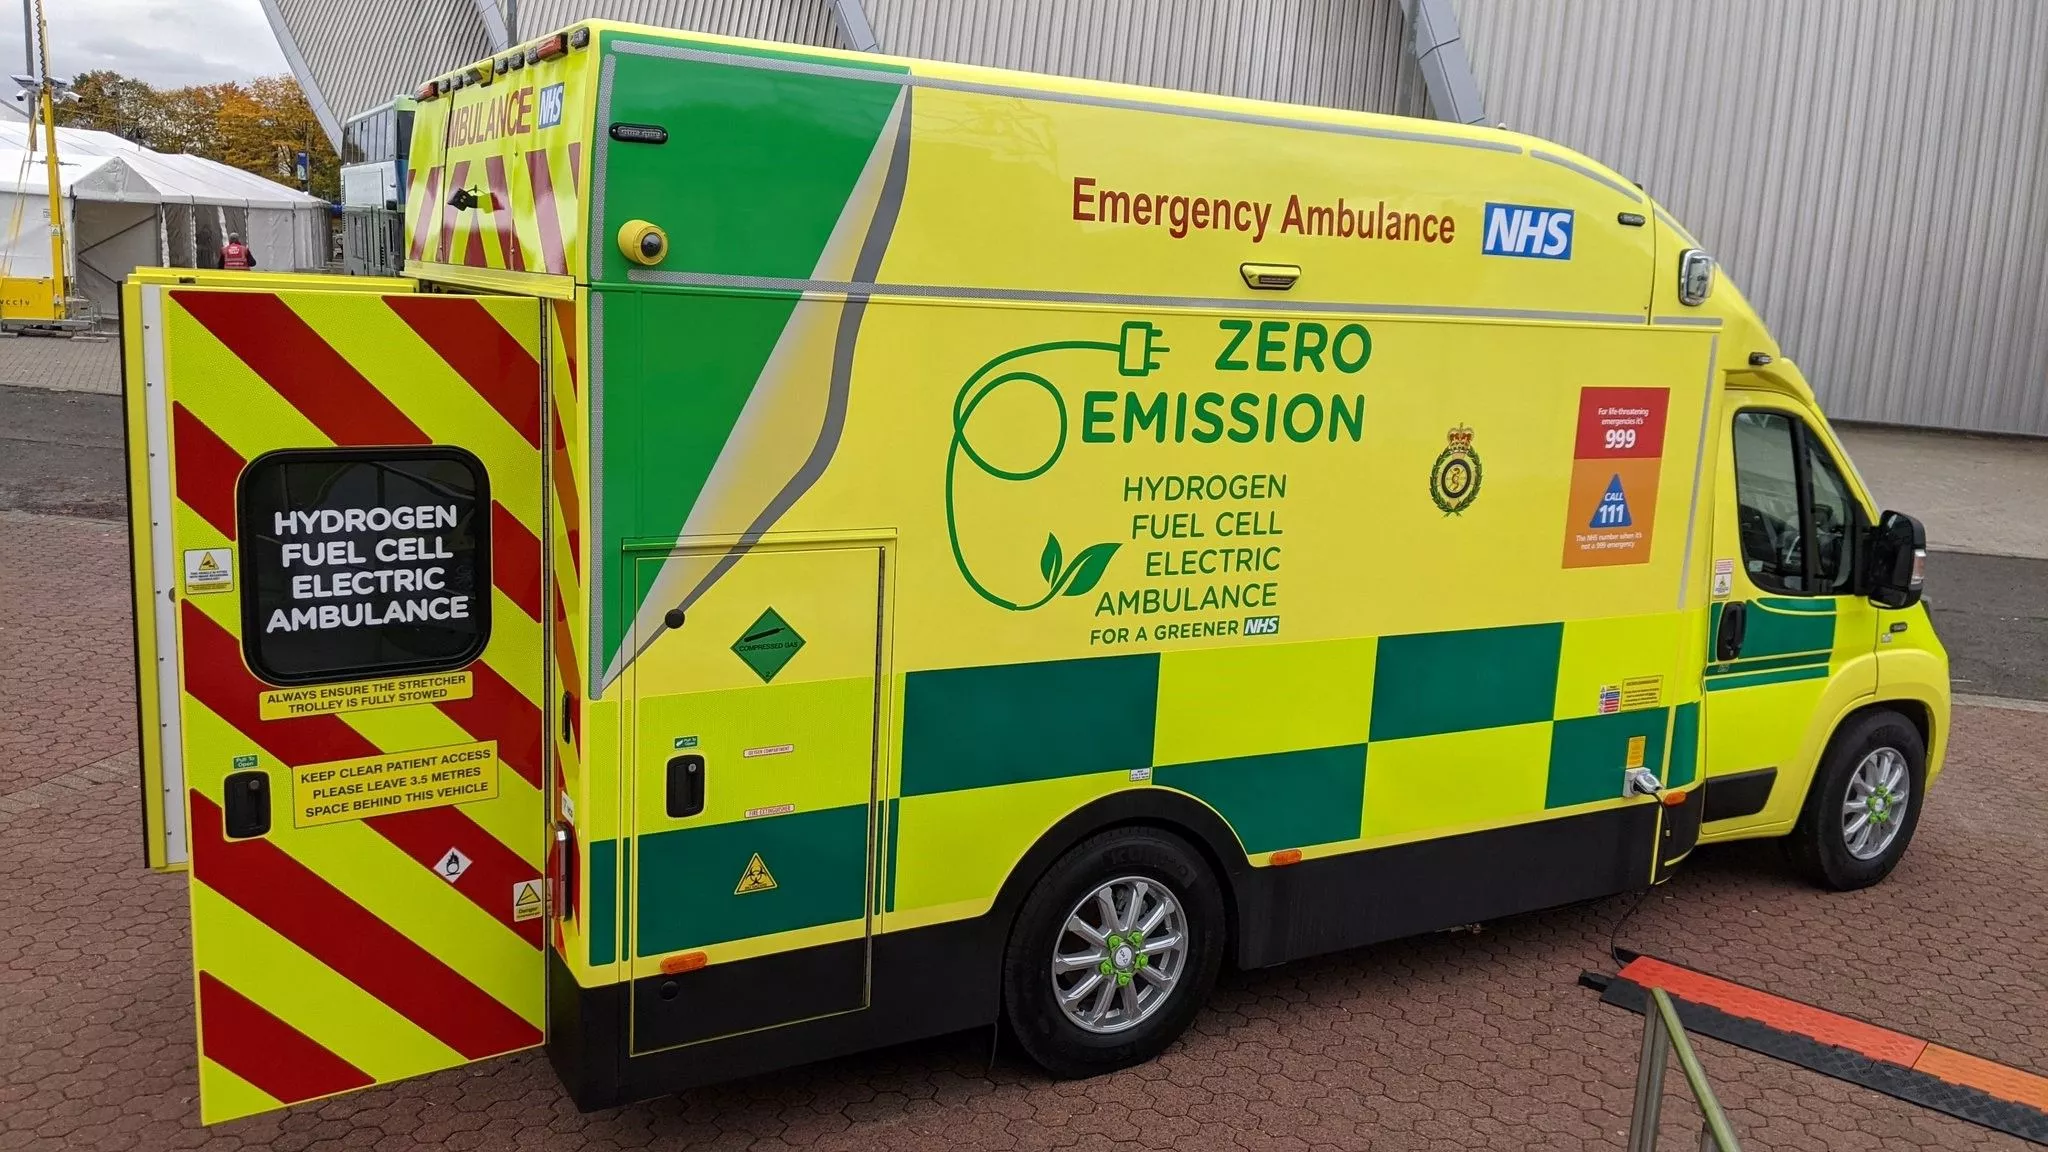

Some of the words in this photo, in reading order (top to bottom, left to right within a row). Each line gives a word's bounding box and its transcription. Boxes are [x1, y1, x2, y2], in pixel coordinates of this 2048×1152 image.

[441, 87, 533, 151] AMBULANCE
[539, 85, 563, 126] NHS
[1073, 176, 1272, 243] Emergency
[1280, 193, 1456, 245] Ambulance
[1484, 206, 1572, 257] NHS
[1214, 319, 1372, 373] ZERO
[1081, 391, 1365, 444] EMISSION
[1598, 407, 1607, 415] For
[1609, 407, 1649, 417] life-threatening
[1601, 418, 1635, 426] emergencies
[1605, 429, 1636, 449] 999
[1123, 474, 1287, 502] HYDROGEN
[1604, 492, 1624, 501] CALL
[275, 504, 457, 536] HYDROGEN
[1131, 513, 1205, 539] FUEL
[1215, 510, 1283, 536] CELL
[1599, 504, 1624, 524] 111
[282, 540, 366, 568] FUEL
[375, 536, 453, 561] CELL
[1145, 546, 1281, 576] ELECTRIC
[292, 567, 445, 600] ELECTRIC
[266, 596, 469, 634] AMBULANCE
[1095, 582, 1278, 617] AMBULANCE
[1090, 627, 1128, 645] FOR
[1135, 626, 1147, 641] A
[1154, 621, 1238, 640] GREENER
[1244, 617, 1278, 635] NHS
[739, 643, 783, 651] COMPRESSED
[267, 691, 317, 704] ALWAYS
[320, 685, 368, 698] ENSURE
[374, 682, 396, 693] THE
[398, 675, 466, 690] STRETCHER
[289, 700, 342, 714] TROLLEY
[346, 698, 358, 708] IS
[361, 695, 394, 706] FULLY
[399, 688, 448, 702] STOWED
[301, 770, 336, 784] KEEP
[340, 764, 382, 780] CLEAR
[386, 757, 436, 773] PATIENT
[441, 750, 490, 765] ACCESS
[313, 784, 364, 800] PLEASE
[367, 778, 406, 792] LEAVE
[410, 774, 428, 786] 3.5
[432, 767, 480, 782] METRES
[306, 803, 349, 818] SPACE
[353, 796, 402, 811] BEHIND
[406, 790, 433, 802] THIS
[437, 782, 488, 798] VEHICLE
